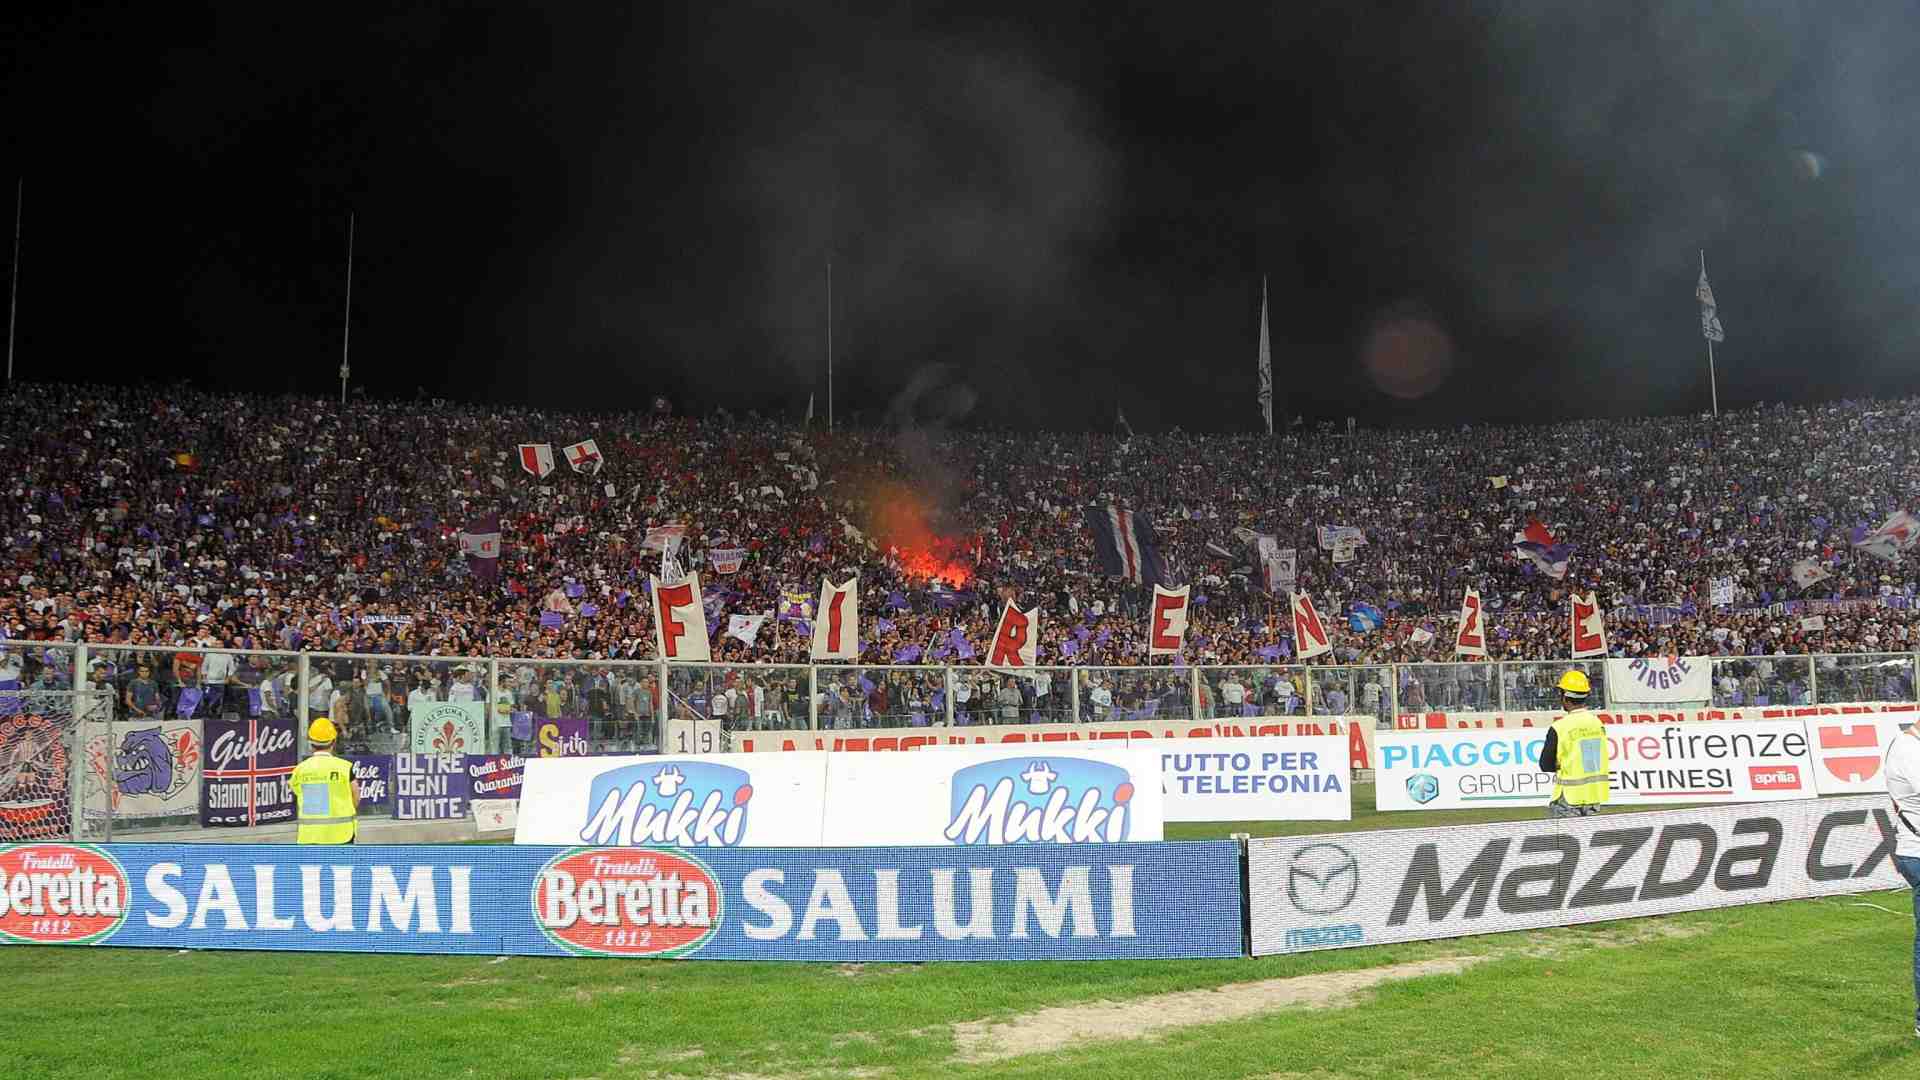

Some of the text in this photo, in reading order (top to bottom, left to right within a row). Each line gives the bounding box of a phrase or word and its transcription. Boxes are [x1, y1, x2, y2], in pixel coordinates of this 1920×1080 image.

[656, 583, 694, 658] F
[827, 591, 845, 654] I
[991, 606, 1028, 668] R
[1154, 593, 1187, 650] E
[1297, 599, 1328, 652] N
[1458, 594, 1483, 650] Z
[1573, 602, 1602, 652] E
[1629, 657, 1692, 690] PIAGGE
[211, 725, 295, 773] Giulia
[396, 752, 465, 774] OLTRE
[539, 723, 587, 758] Sirito
[1262, 752, 1319, 771] PER
[209, 777, 249, 809] siamo
[256, 780, 278, 808] con
[398, 774, 448, 796] OGNI
[1177, 774, 1343, 794] TELEFONIA
[1754, 770, 1797, 786] aprilia
[398, 797, 463, 819] LIMITE
[580, 782, 754, 846] Mukki
[944, 778, 1136, 845] Mukki
[590, 856, 657, 876] Fratelli
[144, 862, 474, 935] SALUMI
[545, 868, 712, 930] Beretta
[742, 865, 1136, 941] SALUMI
[32, 919, 71, 935] 1812
[603, 930, 652, 947] 1812
